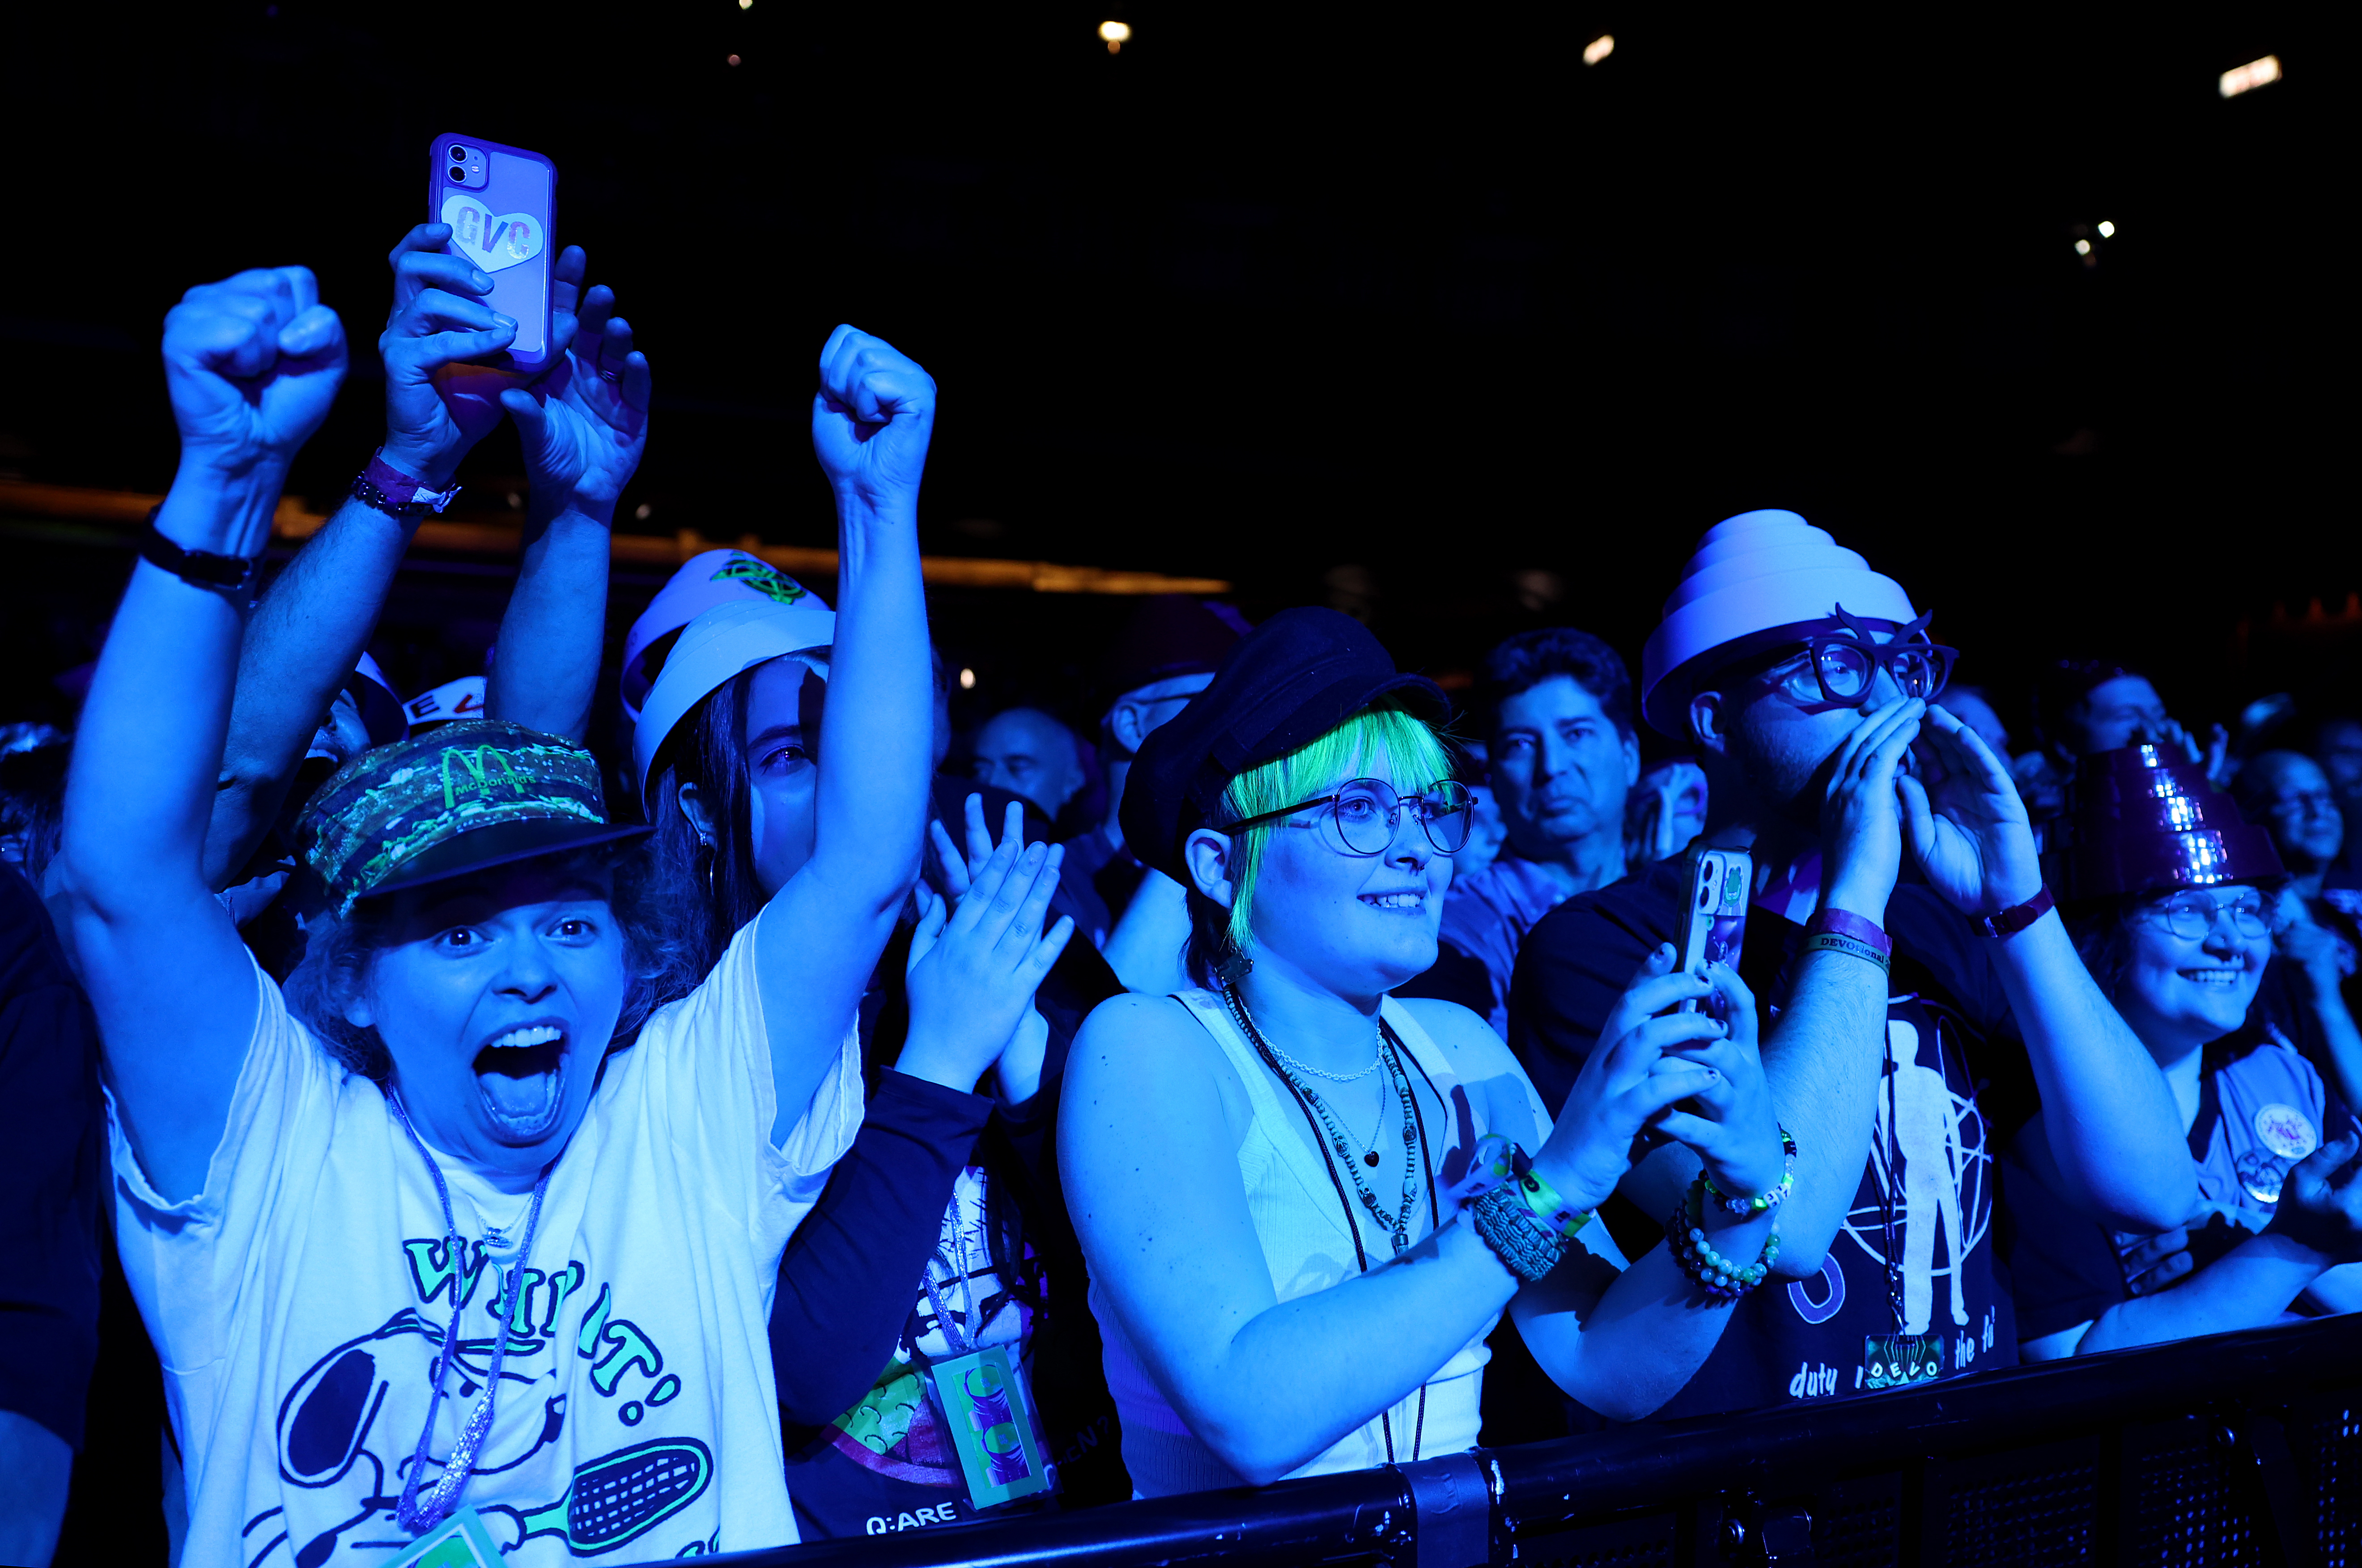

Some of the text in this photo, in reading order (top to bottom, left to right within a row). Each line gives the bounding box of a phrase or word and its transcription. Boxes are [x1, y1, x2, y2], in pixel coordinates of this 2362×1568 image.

[455, 206, 531, 259] GVC
[1789, 1362, 1838, 1399] duty
[1955, 1330, 1975, 1370] the
[1871, 1361, 1938, 1378] DEVO
